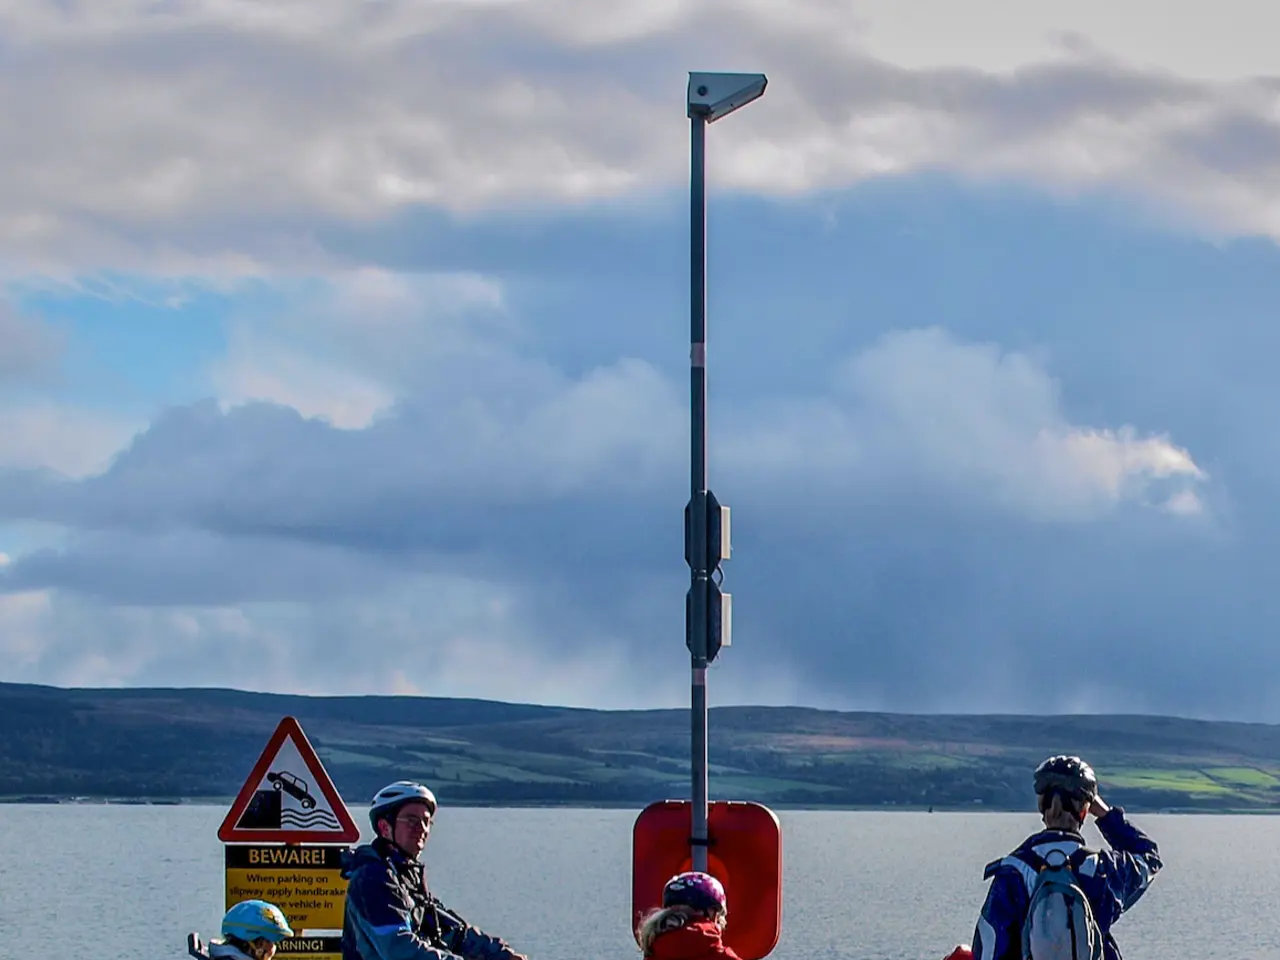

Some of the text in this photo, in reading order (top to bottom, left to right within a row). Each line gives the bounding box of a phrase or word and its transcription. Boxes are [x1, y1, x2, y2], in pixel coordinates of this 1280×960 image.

[249, 849, 326, 864] BEWARE!
[246, 874, 275, 883] When
[277, 874, 313, 885] parking
[230, 887, 346, 897] slipway apply handbrake
[289, 899, 322, 909] vehicle
[324, 899, 333, 909] in
[288, 914, 308, 922] gear
